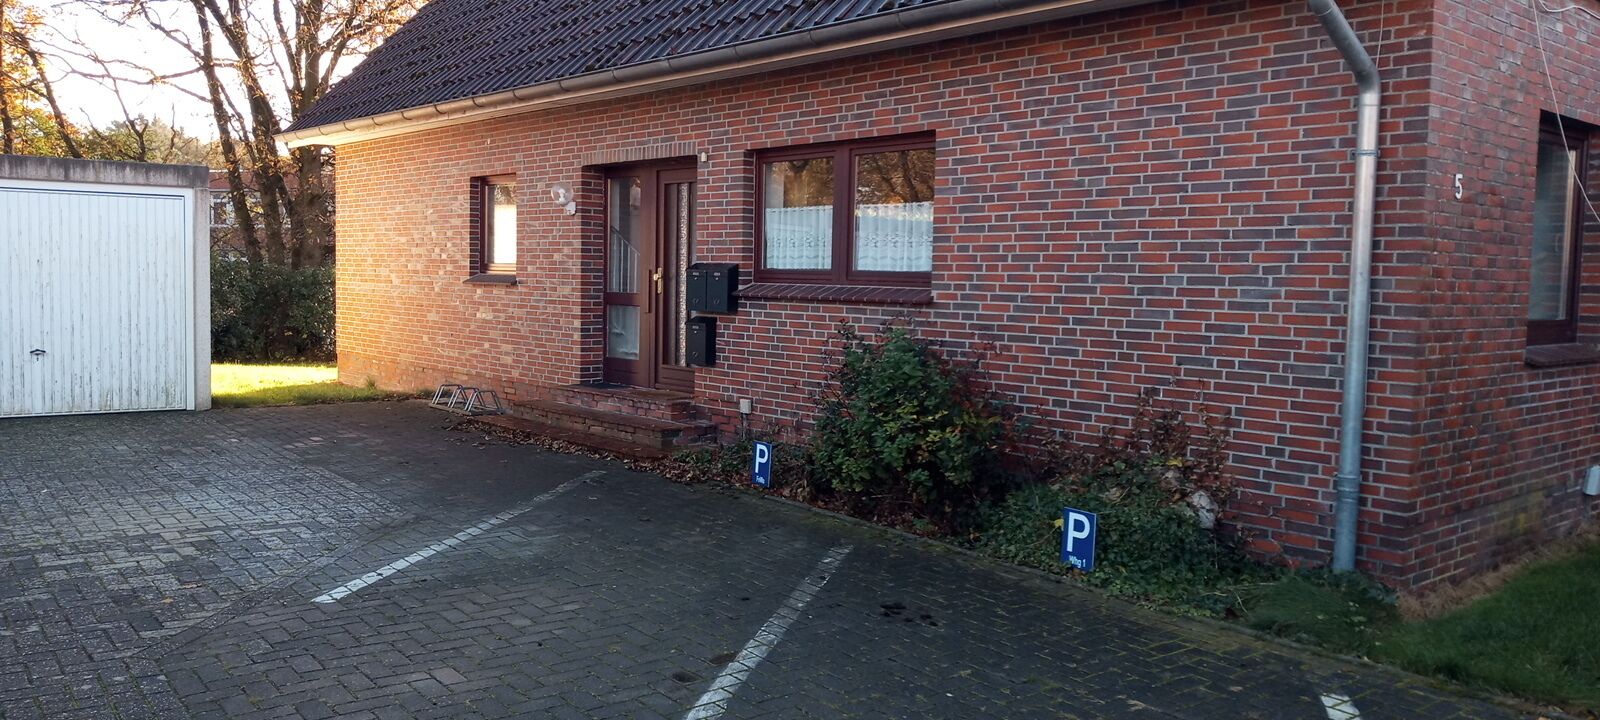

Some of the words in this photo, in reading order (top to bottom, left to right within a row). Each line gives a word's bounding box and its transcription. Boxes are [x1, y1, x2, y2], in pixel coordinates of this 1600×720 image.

[1455, 173, 1463, 199] 5
[755, 443, 768, 473] P
[1067, 512, 1090, 552] P
